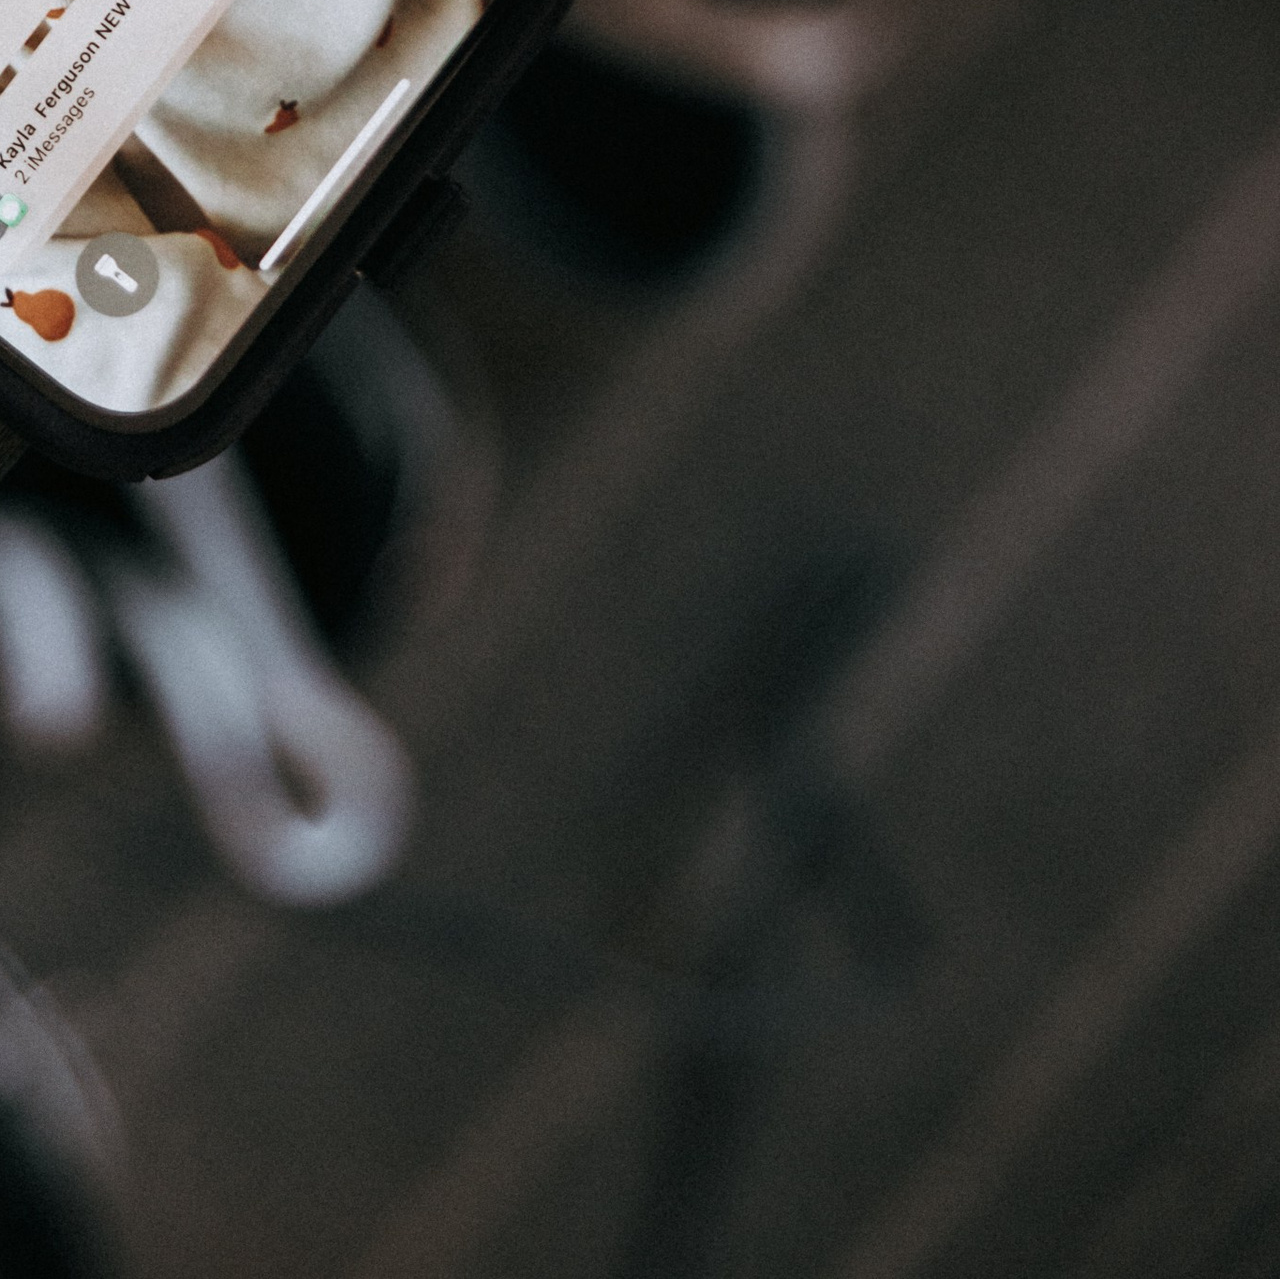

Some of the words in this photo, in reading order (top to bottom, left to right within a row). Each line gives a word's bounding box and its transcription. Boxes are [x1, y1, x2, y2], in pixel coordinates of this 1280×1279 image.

[34, 41, 100, 119] Ferguson
[14, 169, 30, 185] 2
[27, 87, 95, 171] iMessages
